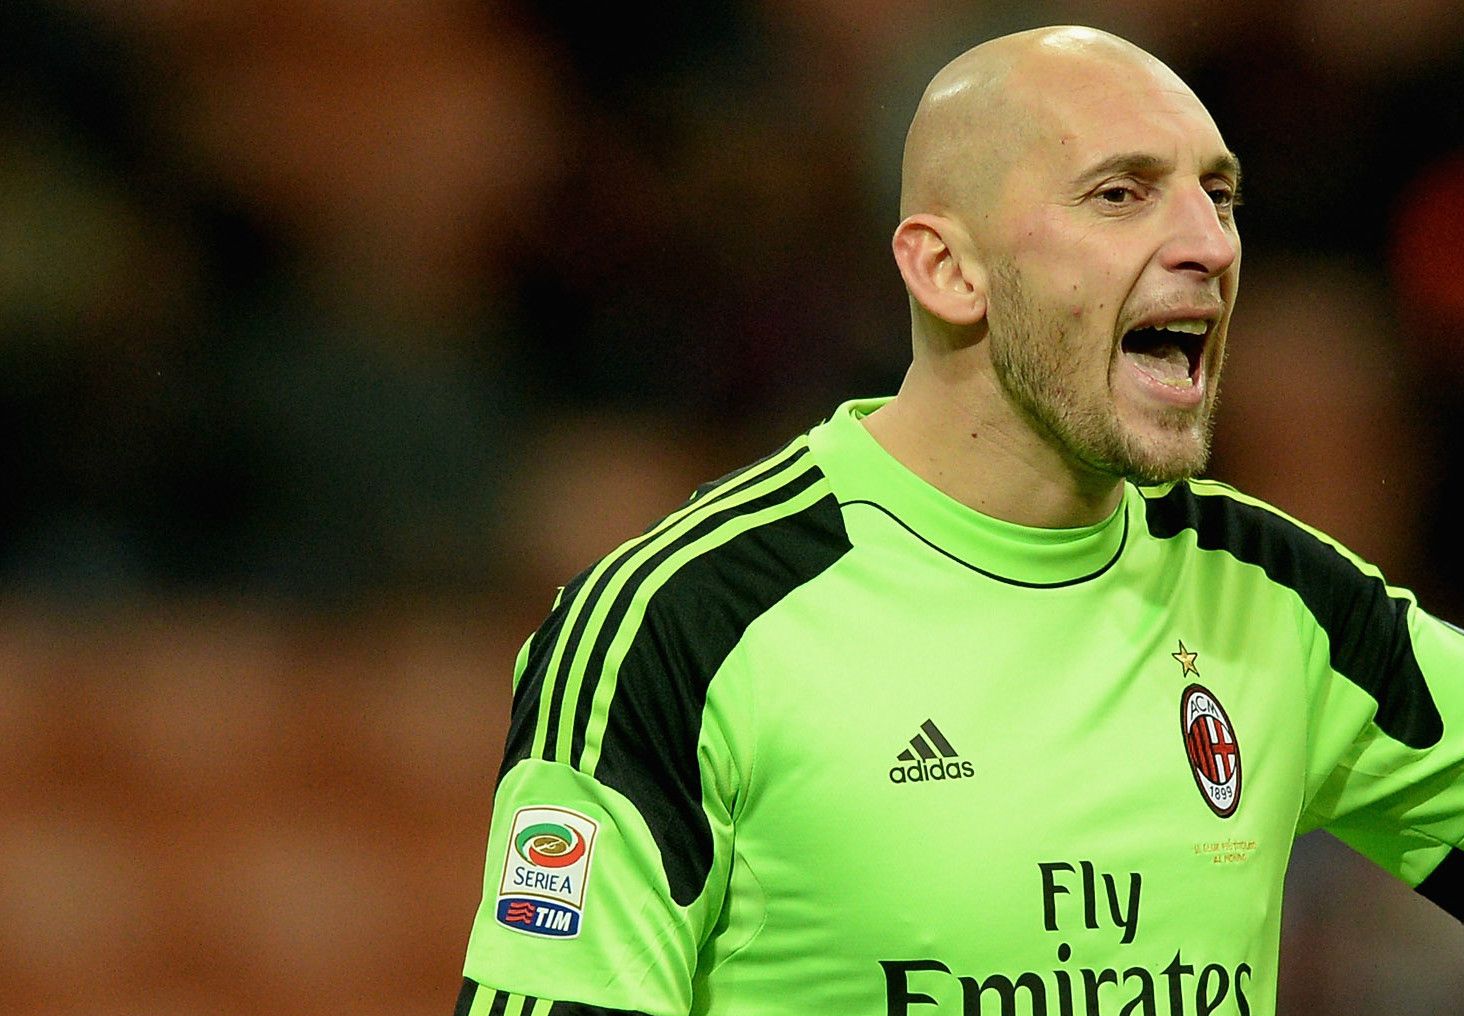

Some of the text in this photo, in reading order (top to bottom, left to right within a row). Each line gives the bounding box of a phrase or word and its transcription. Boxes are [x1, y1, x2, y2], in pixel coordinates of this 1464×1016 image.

[1190, 695, 1219, 718] ACM
[889, 759, 975, 784] adidas
[1208, 785, 1233, 801] 1899
[513, 866, 572, 894] SERIE A
[1037, 861, 1142, 944] Fly
[535, 907, 572, 931] TIM
